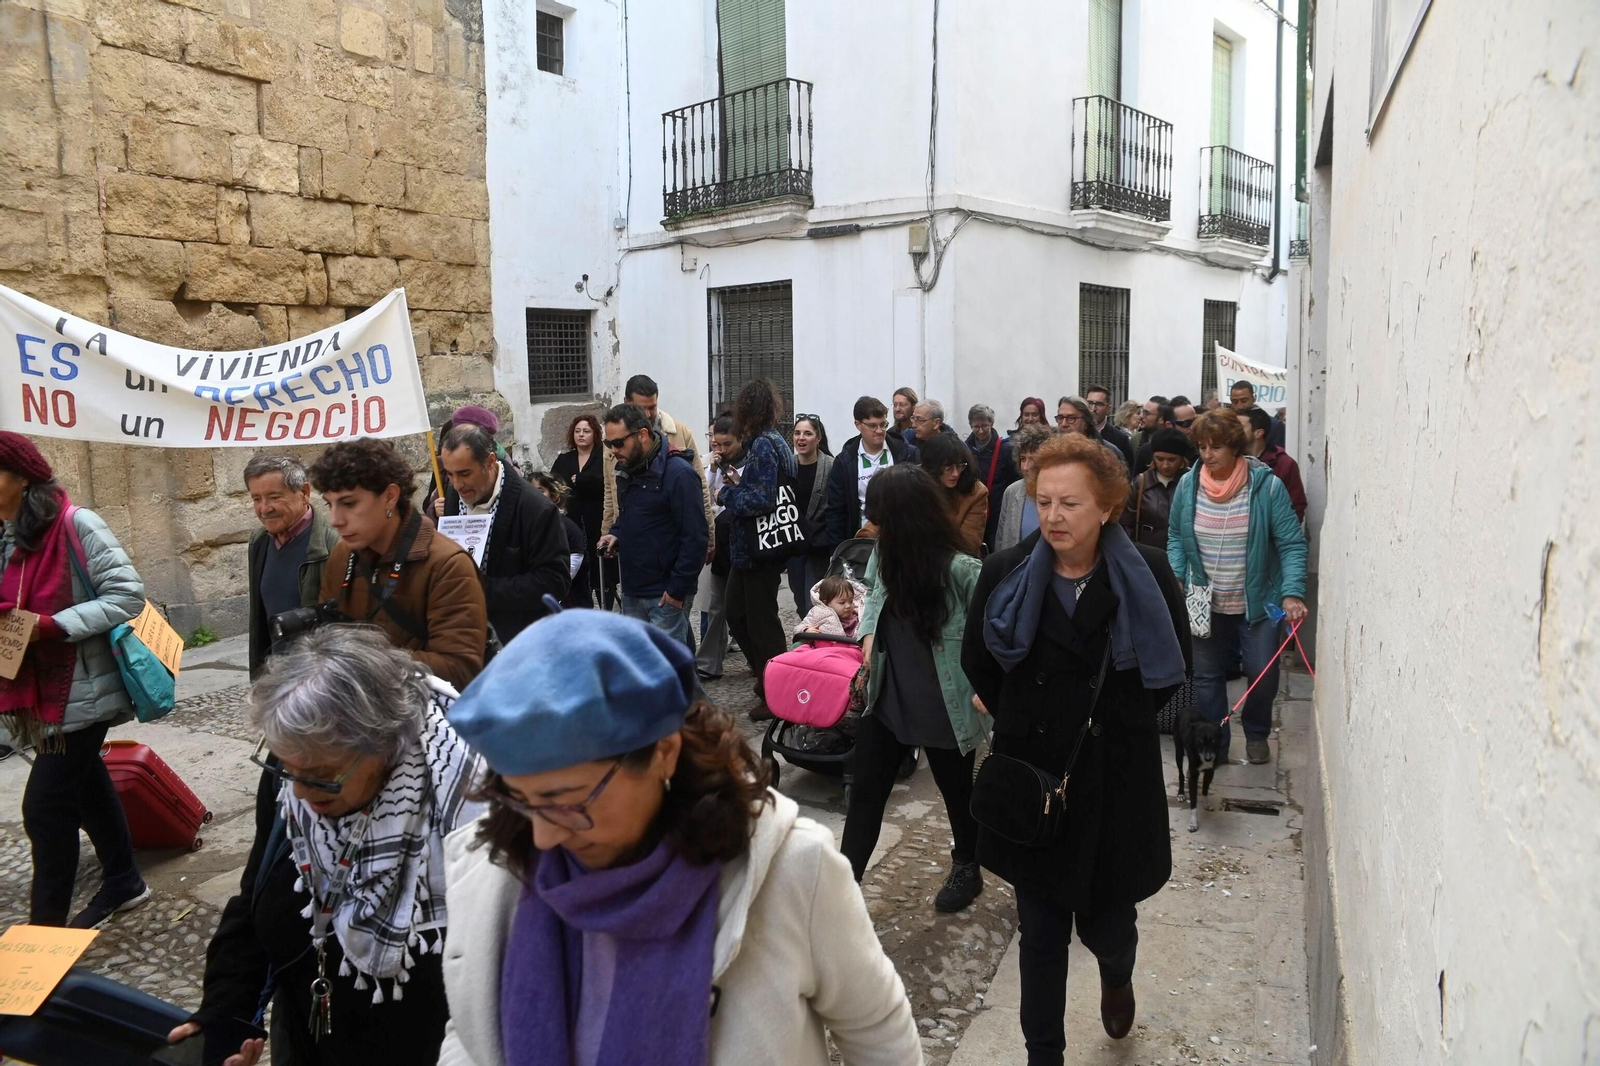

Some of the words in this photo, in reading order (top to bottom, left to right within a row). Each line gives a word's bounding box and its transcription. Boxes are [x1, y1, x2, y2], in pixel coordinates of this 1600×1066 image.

[16, 333, 80, 381] ES
[22, 383, 76, 428] NO
[121, 413, 164, 439] un
[756, 504, 799, 533] BAGO
[758, 523, 805, 550] KITA
